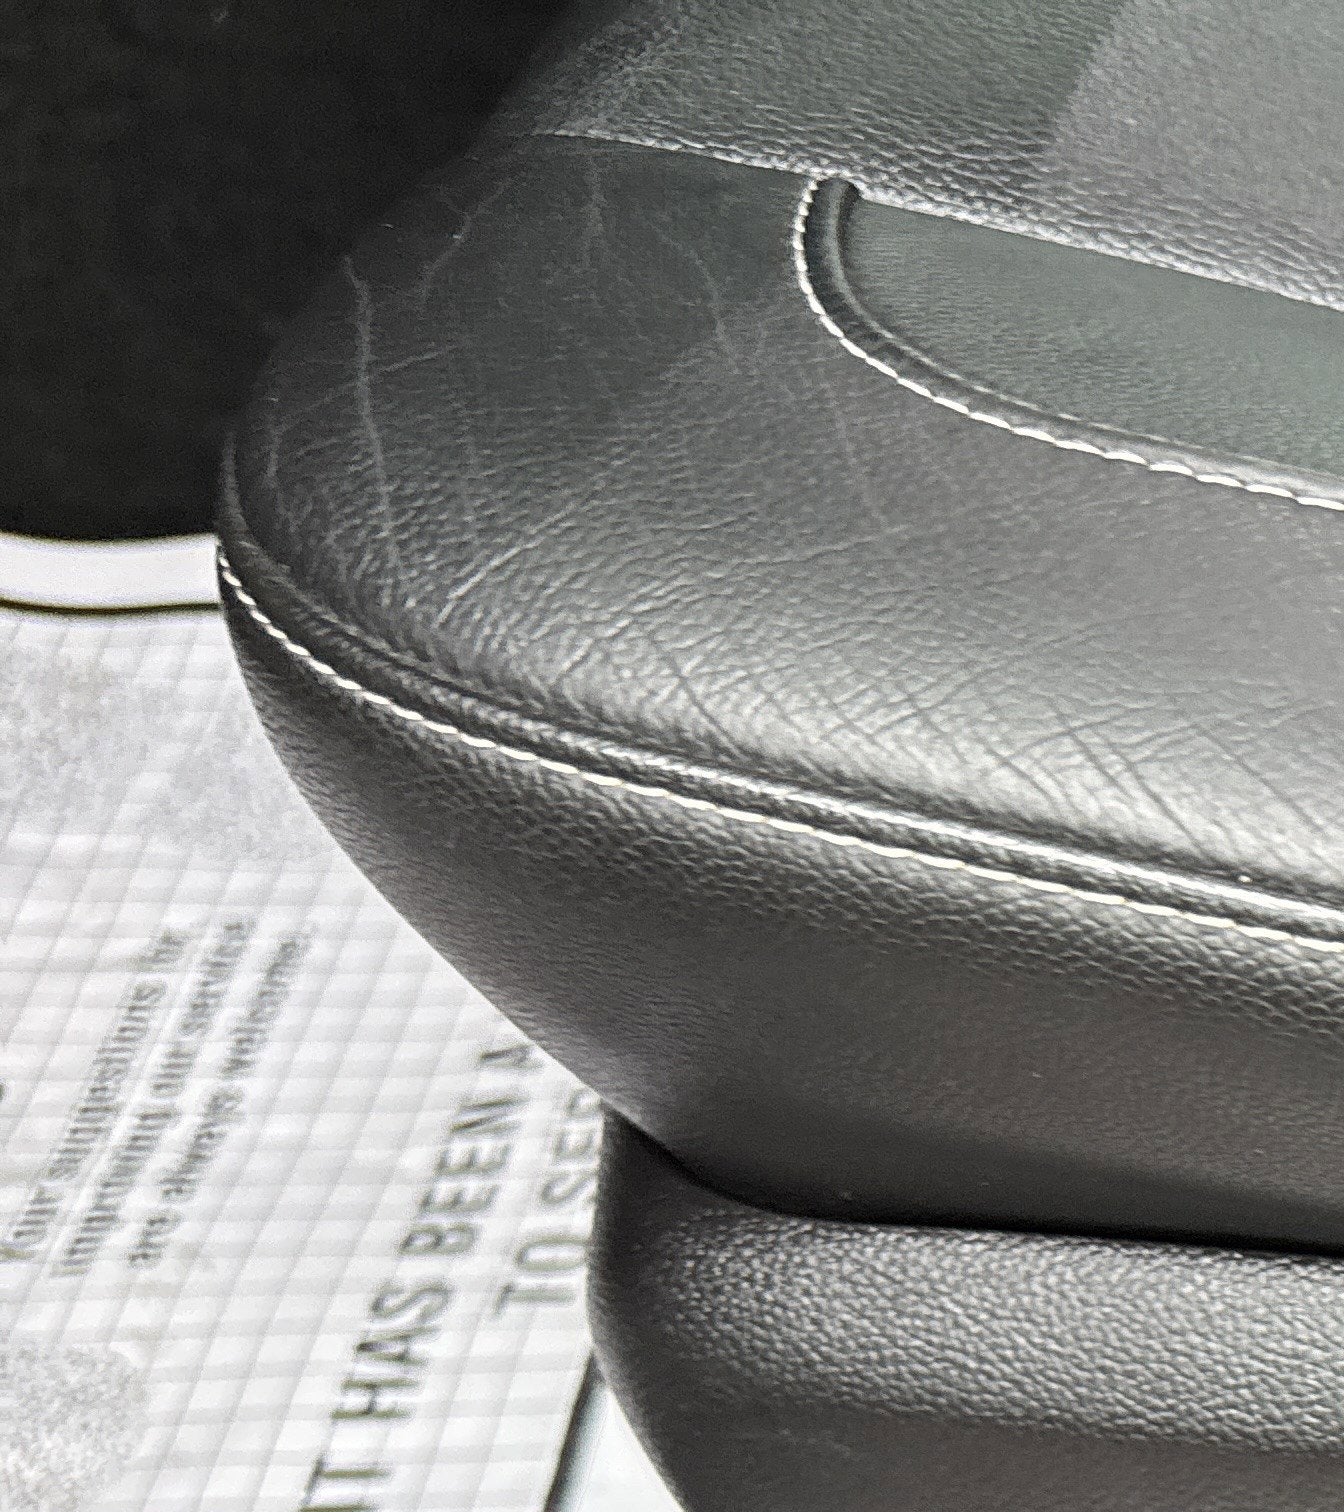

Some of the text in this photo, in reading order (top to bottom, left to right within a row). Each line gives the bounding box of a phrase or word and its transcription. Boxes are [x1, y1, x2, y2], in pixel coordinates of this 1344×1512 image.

[330, 1278, 456, 1420] HAS
[403, 1092, 532, 1257] BEEN
[494, 1233, 588, 1317] TO
